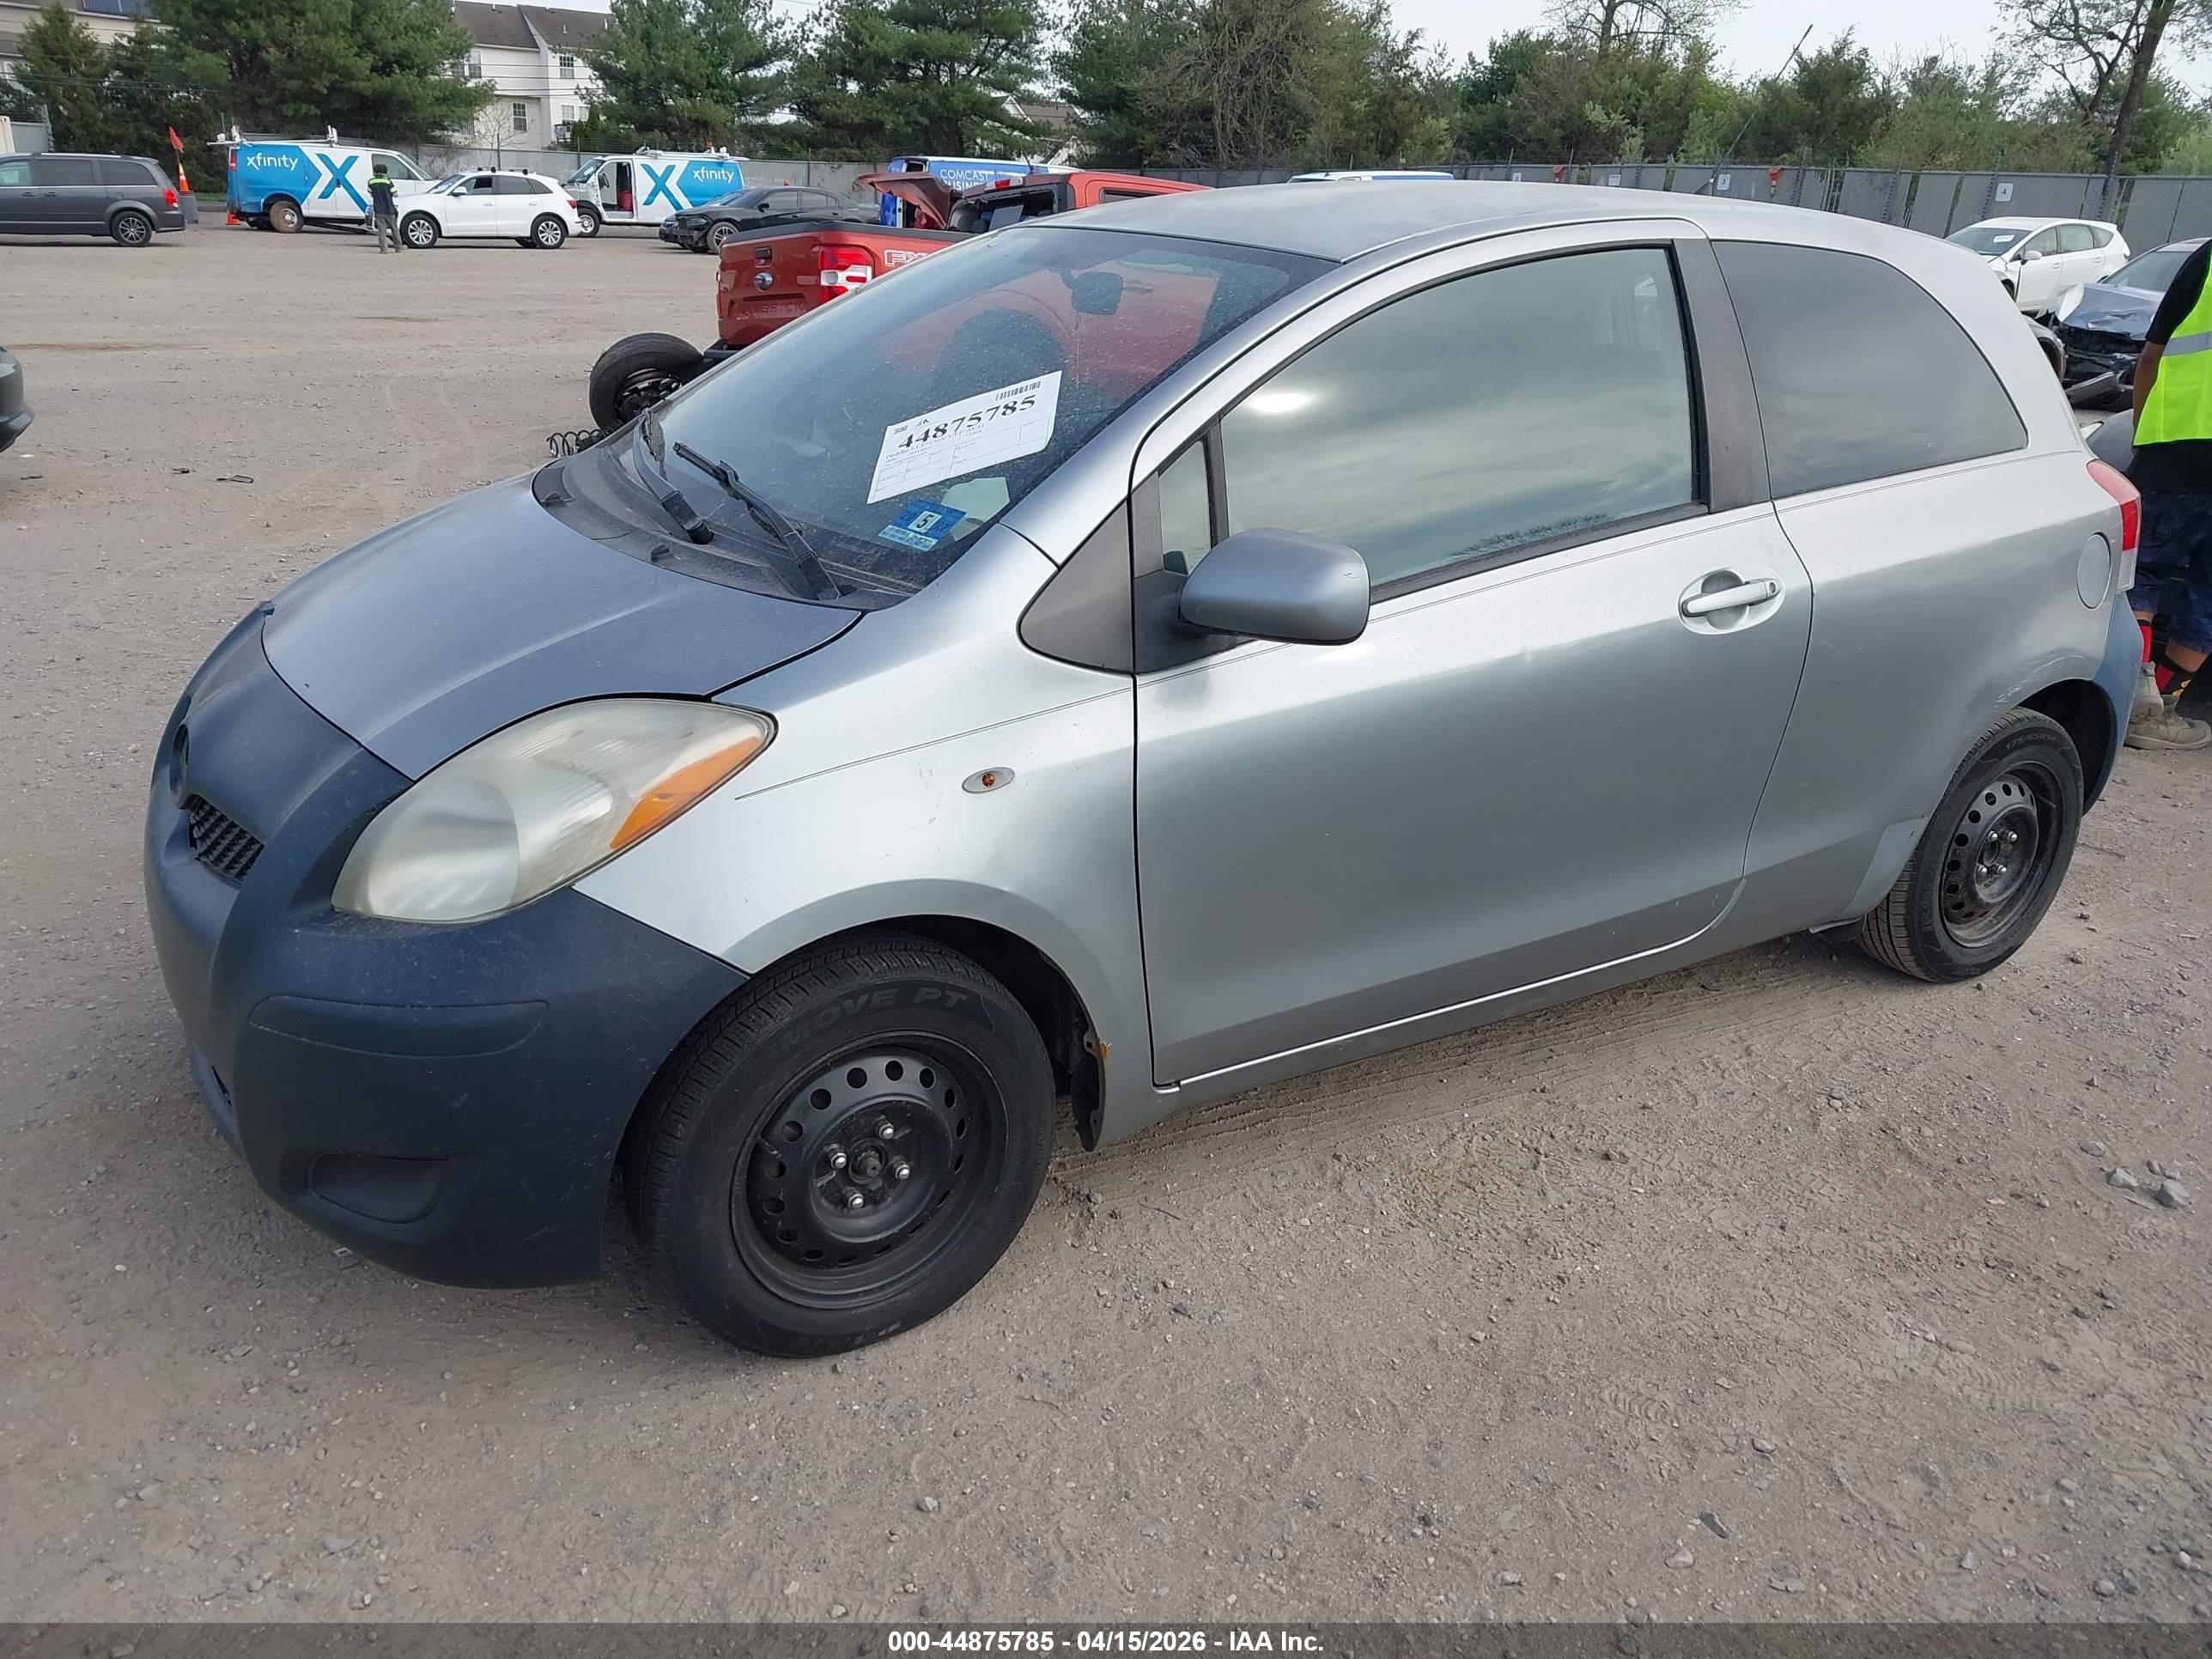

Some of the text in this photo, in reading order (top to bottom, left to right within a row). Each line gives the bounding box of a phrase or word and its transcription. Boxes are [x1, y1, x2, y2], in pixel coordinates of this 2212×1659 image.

[246, 152, 299, 172] xfinity
[693, 166, 734, 184] xfinity
[939, 168, 988, 181] COMCAST
[897, 393, 1037, 450] 44875785
[916, 514, 935, 529] 5
[914, 988, 968, 1008] PT
